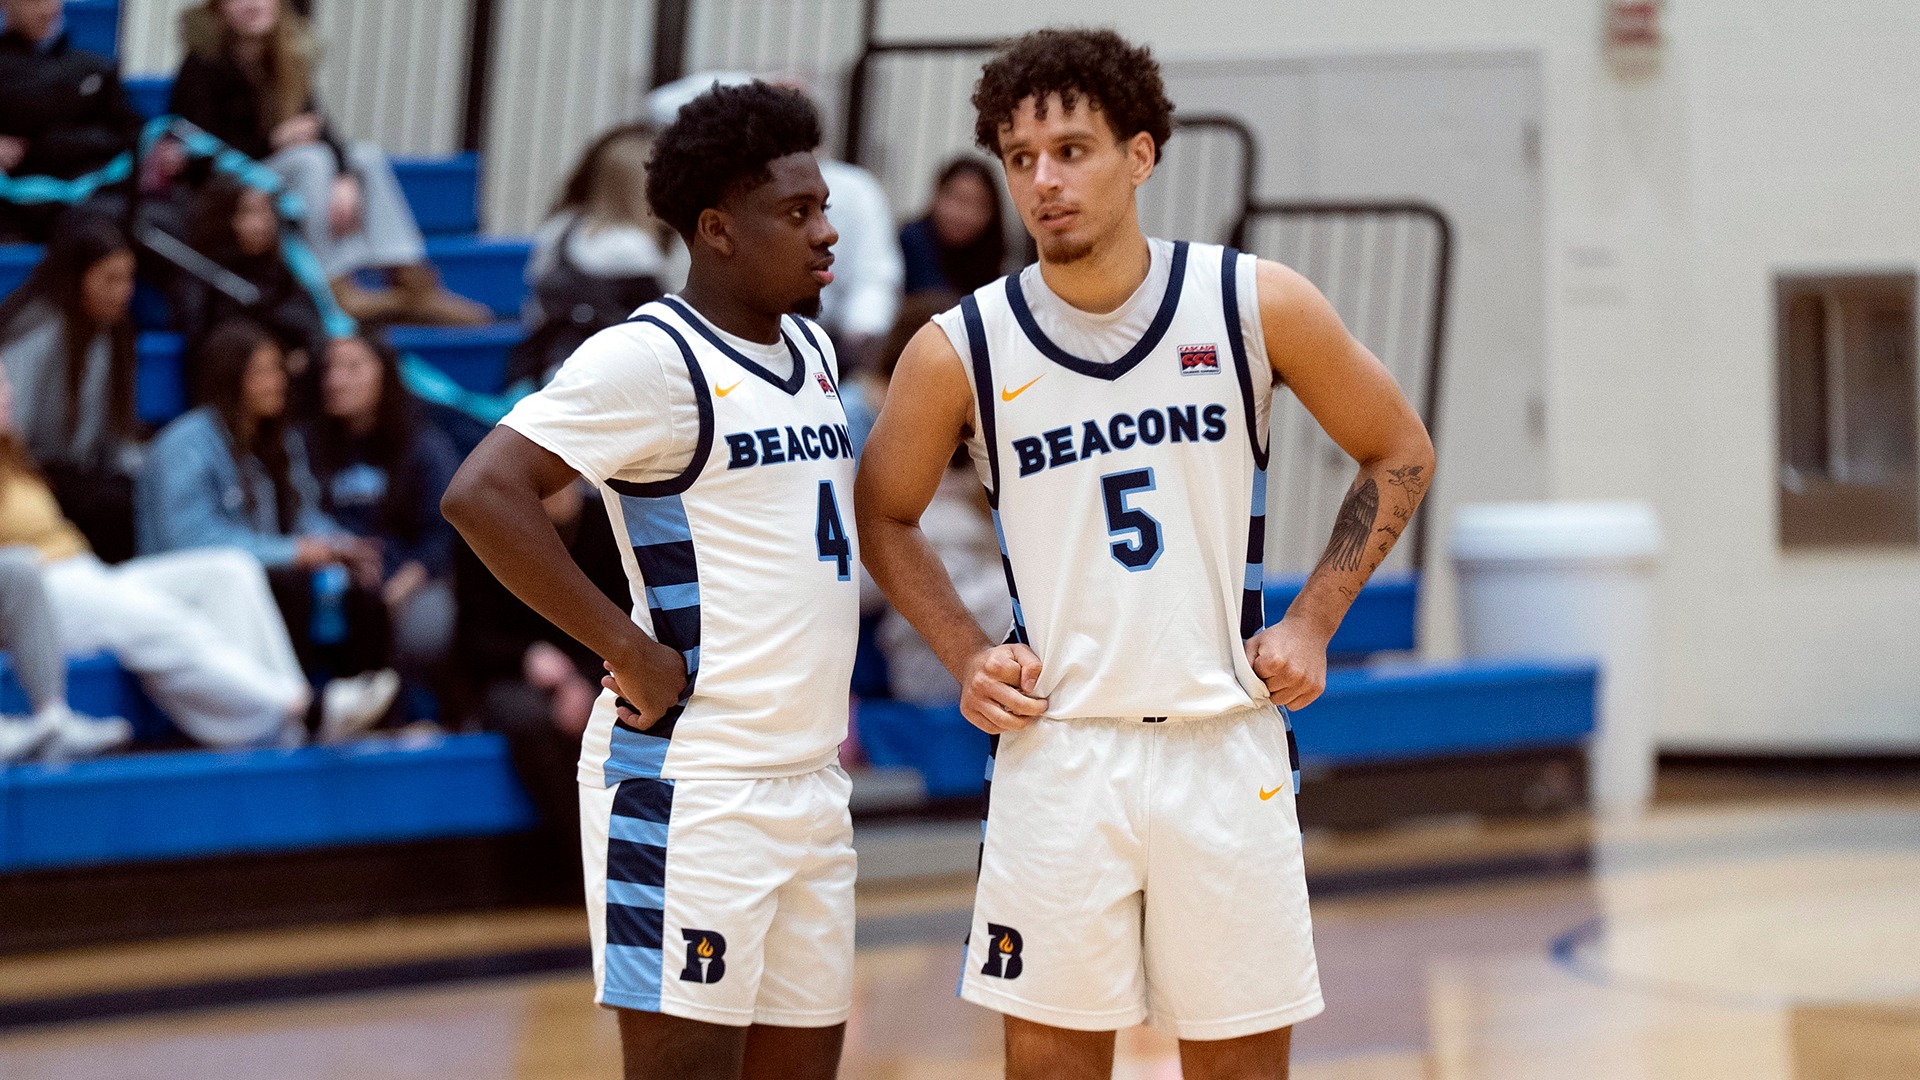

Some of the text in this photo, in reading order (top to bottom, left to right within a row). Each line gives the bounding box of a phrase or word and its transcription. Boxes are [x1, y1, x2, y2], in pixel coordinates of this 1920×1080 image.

[1011, 403, 1228, 479] BEACONS
[815, 479, 853, 582] 4
[1100, 466, 1165, 573] 5
[679, 928, 727, 985] B
[980, 922, 1024, 980] B
